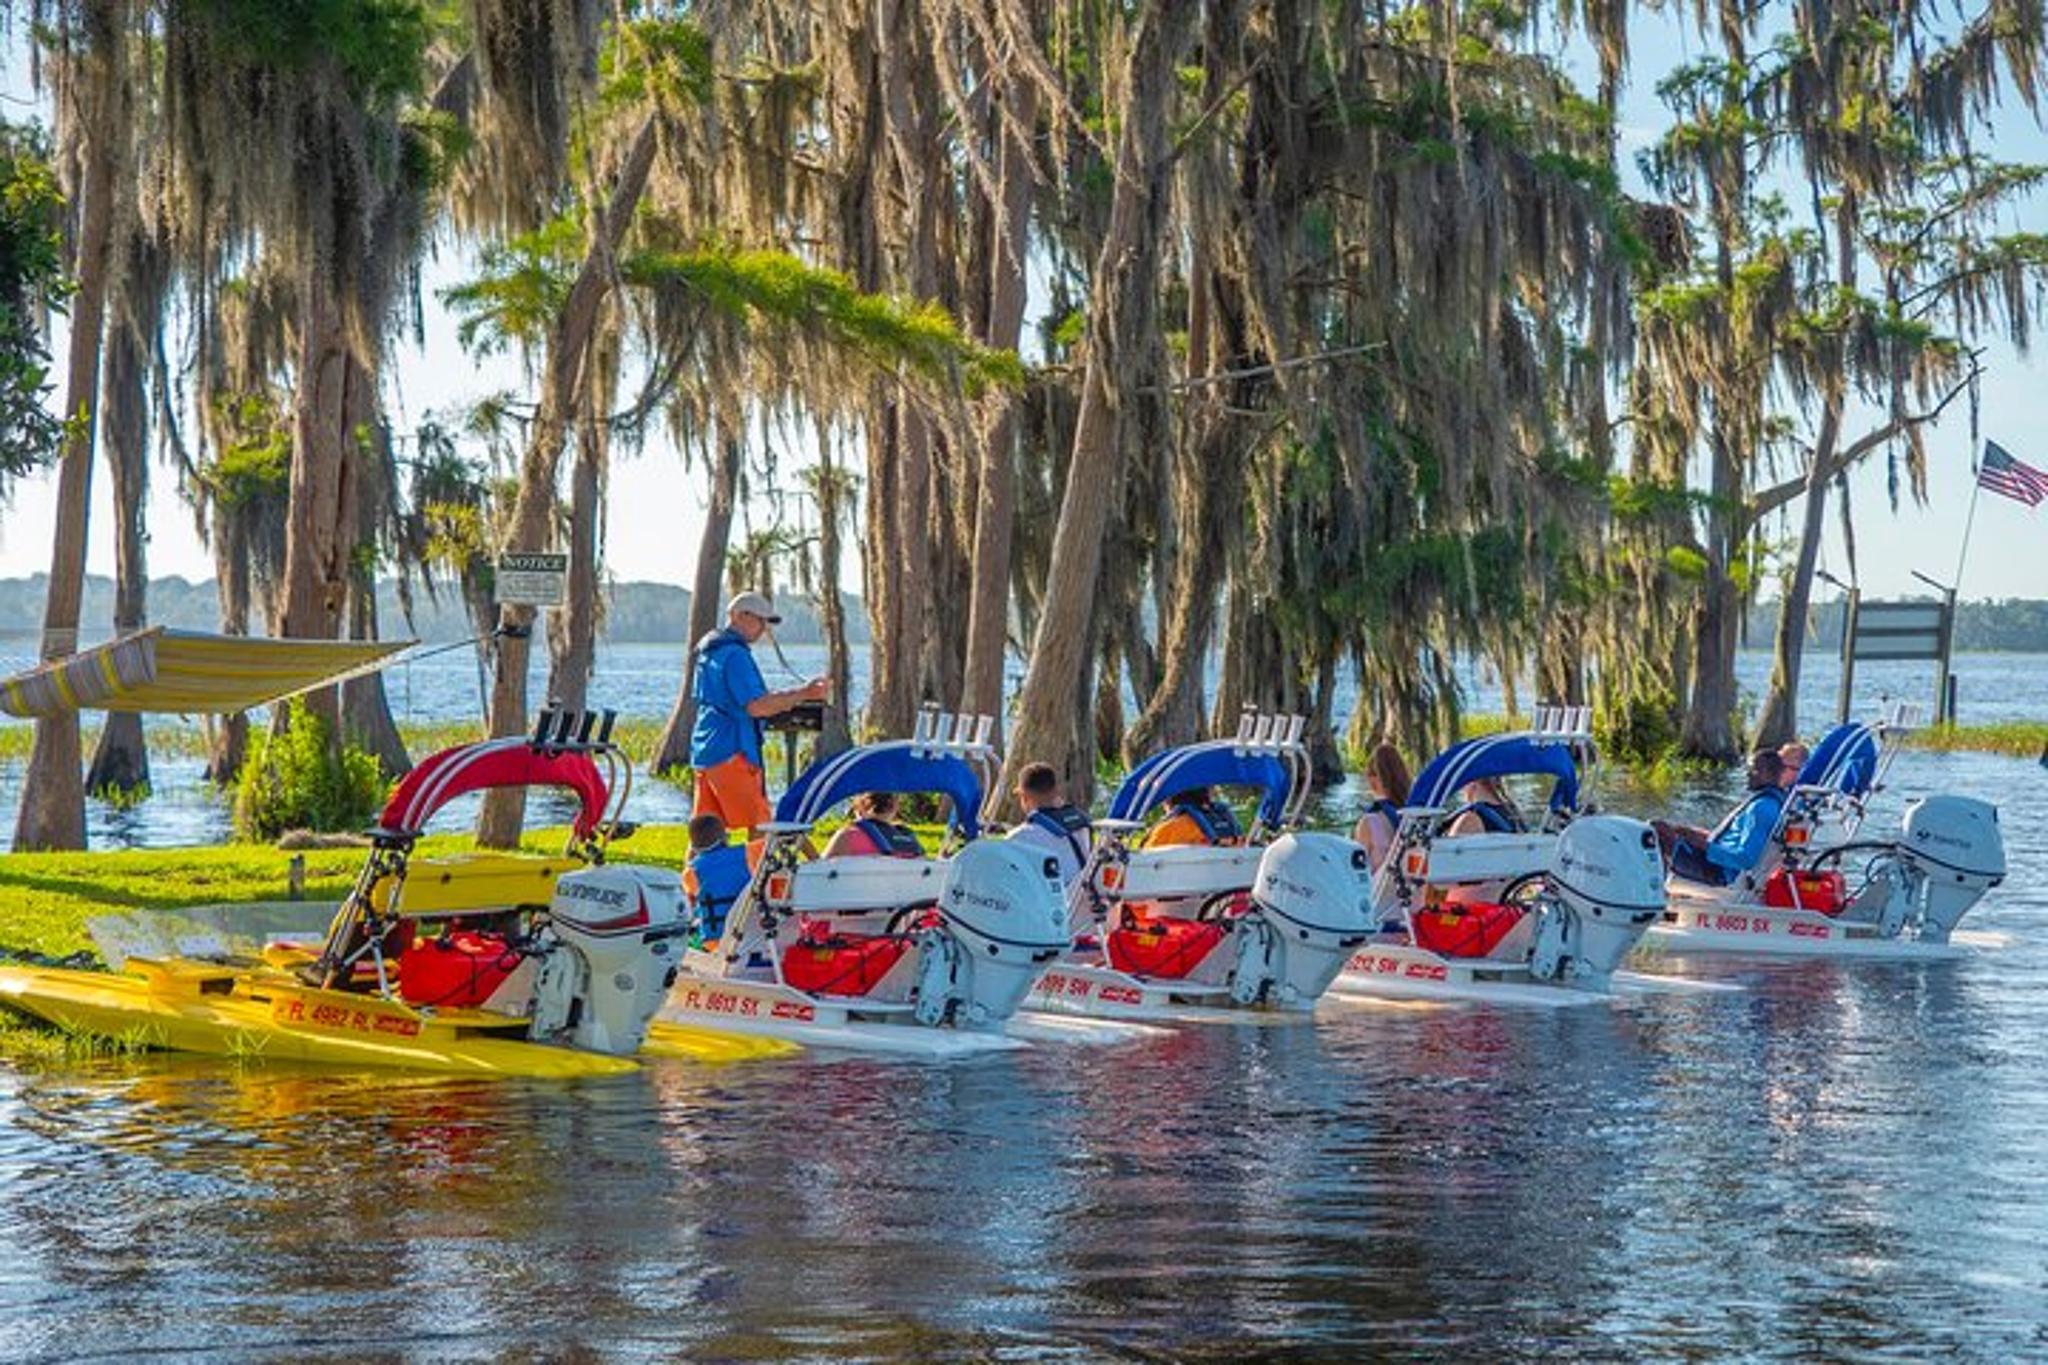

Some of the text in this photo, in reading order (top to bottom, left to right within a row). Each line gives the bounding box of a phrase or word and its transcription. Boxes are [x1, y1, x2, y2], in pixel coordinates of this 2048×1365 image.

[503, 556, 564, 569] NOTICE
[1696, 911, 1710, 928] FL
[684, 989, 701, 1008] FL
[290, 1000, 305, 1021] FL
